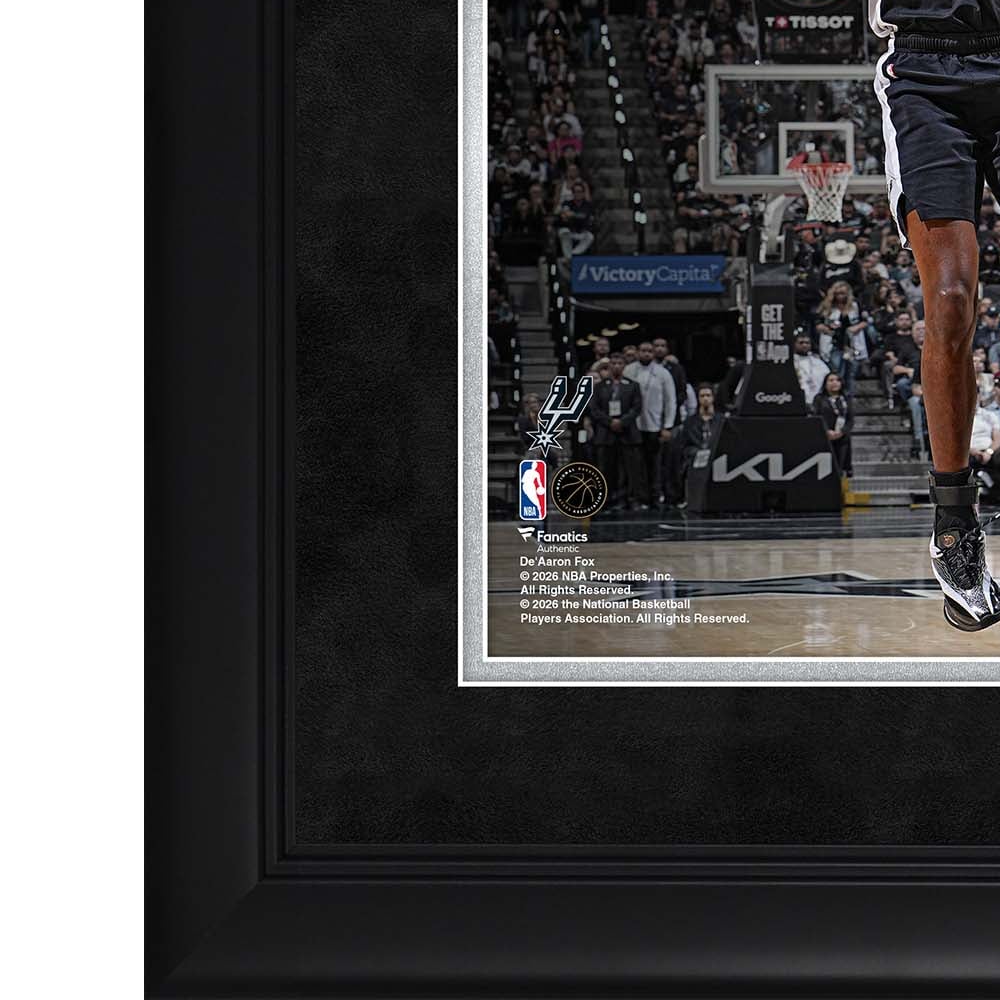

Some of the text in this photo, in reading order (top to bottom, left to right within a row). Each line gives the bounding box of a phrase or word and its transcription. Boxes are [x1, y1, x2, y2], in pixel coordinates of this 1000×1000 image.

[788, 15, 855, 30] TISSOT
[761, 303, 784, 322] GET
[761, 322, 784, 340] THE
[755, 391, 793, 406] Google
